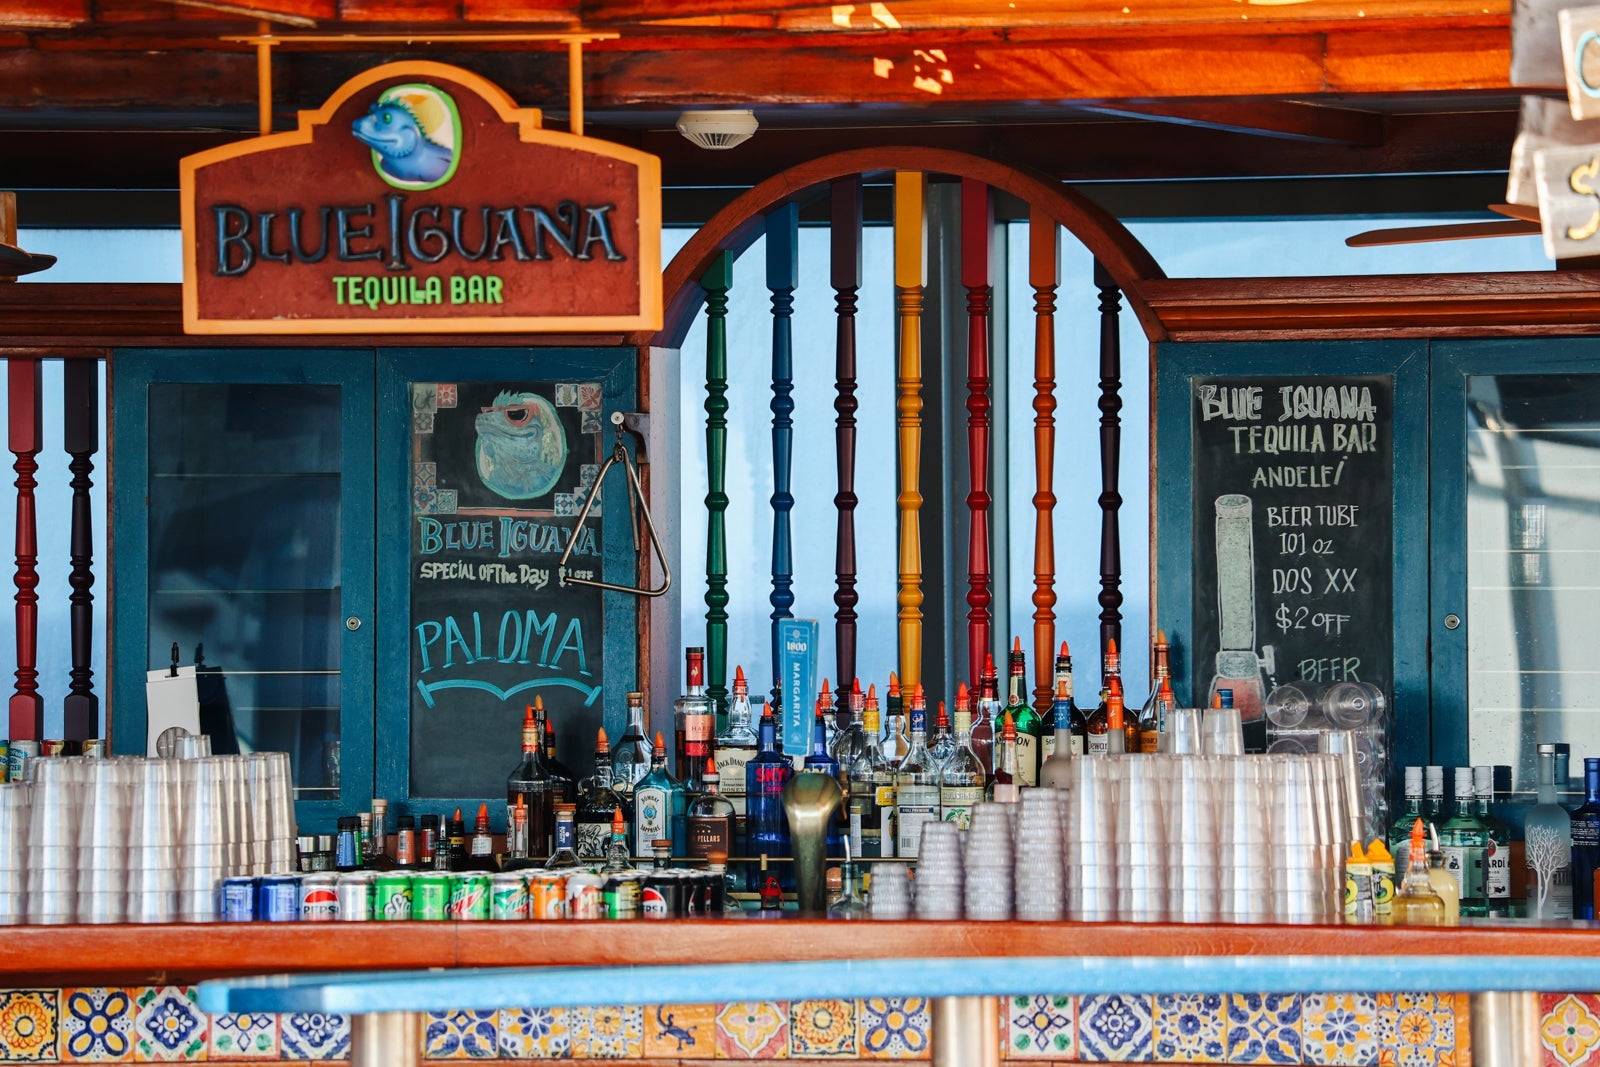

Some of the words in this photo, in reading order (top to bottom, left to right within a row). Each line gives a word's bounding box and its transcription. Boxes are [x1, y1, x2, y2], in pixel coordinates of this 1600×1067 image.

[211, 203, 383, 278] BLUE
[383, 193, 628, 271] IGUANA
[332, 275, 442, 310] TEQUILA
[450, 275, 504, 305] BAR
[1199, 384, 1263, 422] BLUE
[1277, 384, 1377, 422] IGUANA
[1227, 424, 1326, 455] TEQUILA
[1332, 422, 1377, 454] BAR
[1266, 505, 1313, 528] BEER
[1314, 504, 1360, 528] TUBE
[418, 516, 494, 555] BLUE
[499, 516, 602, 557] IGUANA
[1278, 532, 1306, 556] 101
[520, 566, 549, 590] Day
[1271, 566, 1313, 595] DOS
[1323, 567, 1358, 595] XX
[1274, 602, 1310, 635] $2
[1311, 612, 1351, 635] OFF
[415, 609, 593, 677] PALOMA
[786, 641, 807, 652] 1800
[793, 662, 801, 728] MARGARITA
[303, 905, 339, 915] PEPSI
